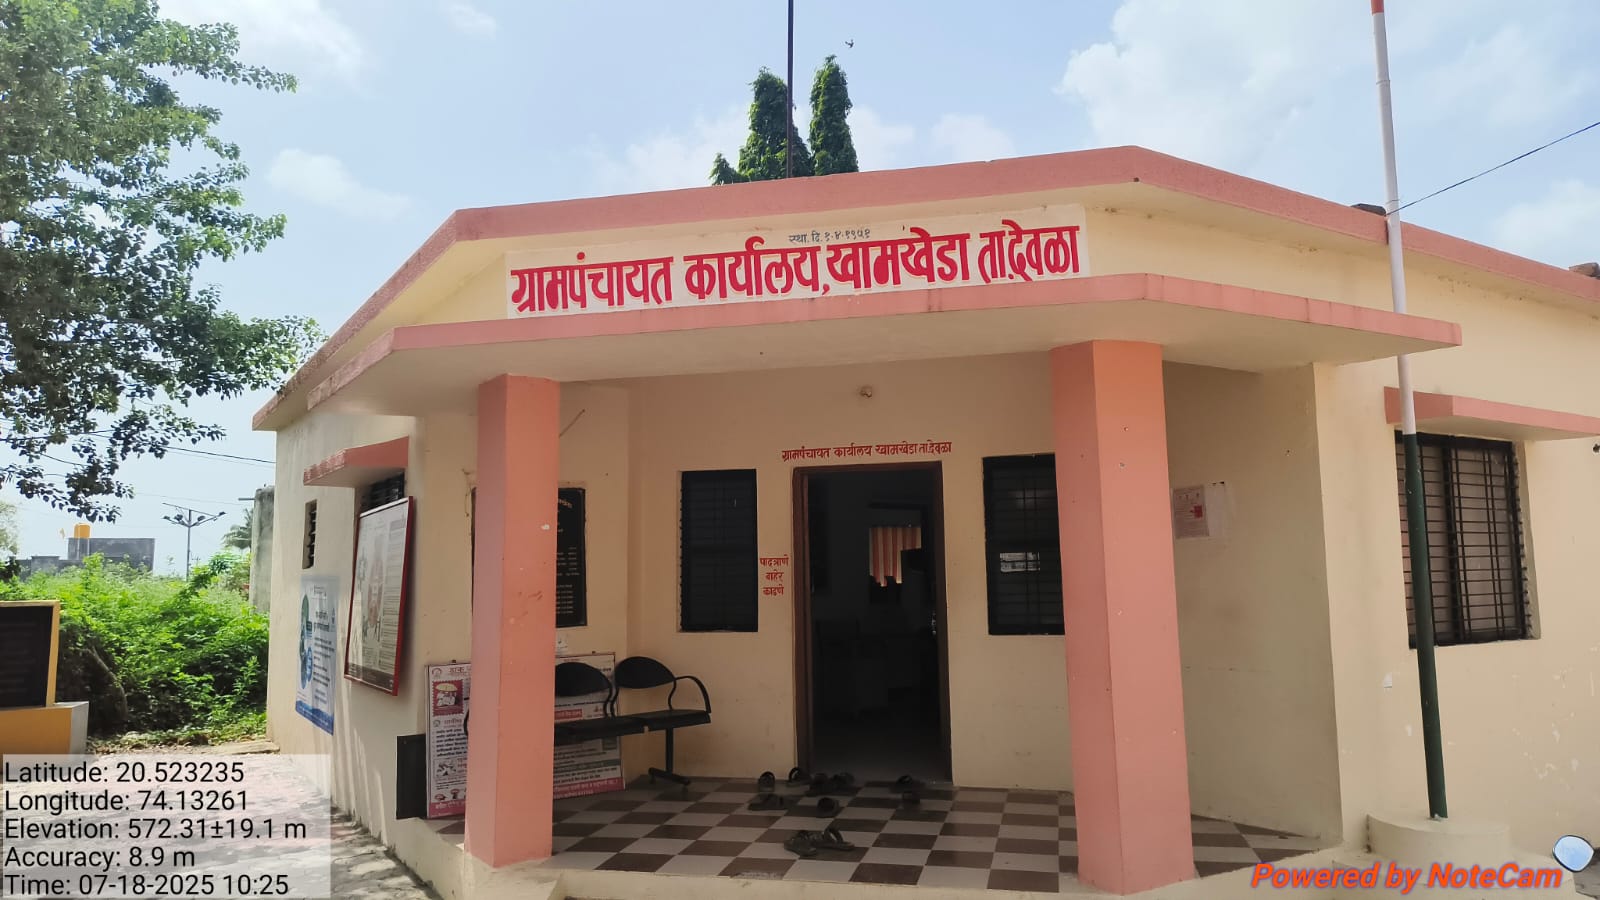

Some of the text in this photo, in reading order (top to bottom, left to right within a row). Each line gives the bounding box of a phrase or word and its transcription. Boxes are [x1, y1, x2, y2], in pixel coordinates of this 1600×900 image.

[510, 252, 674, 312] ग्रामपंचायत
[827, 227, 971, 289] खामखेडा
[782, 445, 831, 462] ग्रामपंचायत
[833, 442, 872, 457] कार्यालय
[875, 440, 917, 455] खामखेडा
[759, 553, 789, 567] पादत्राणे
[765, 569, 784, 582] बाहेर
